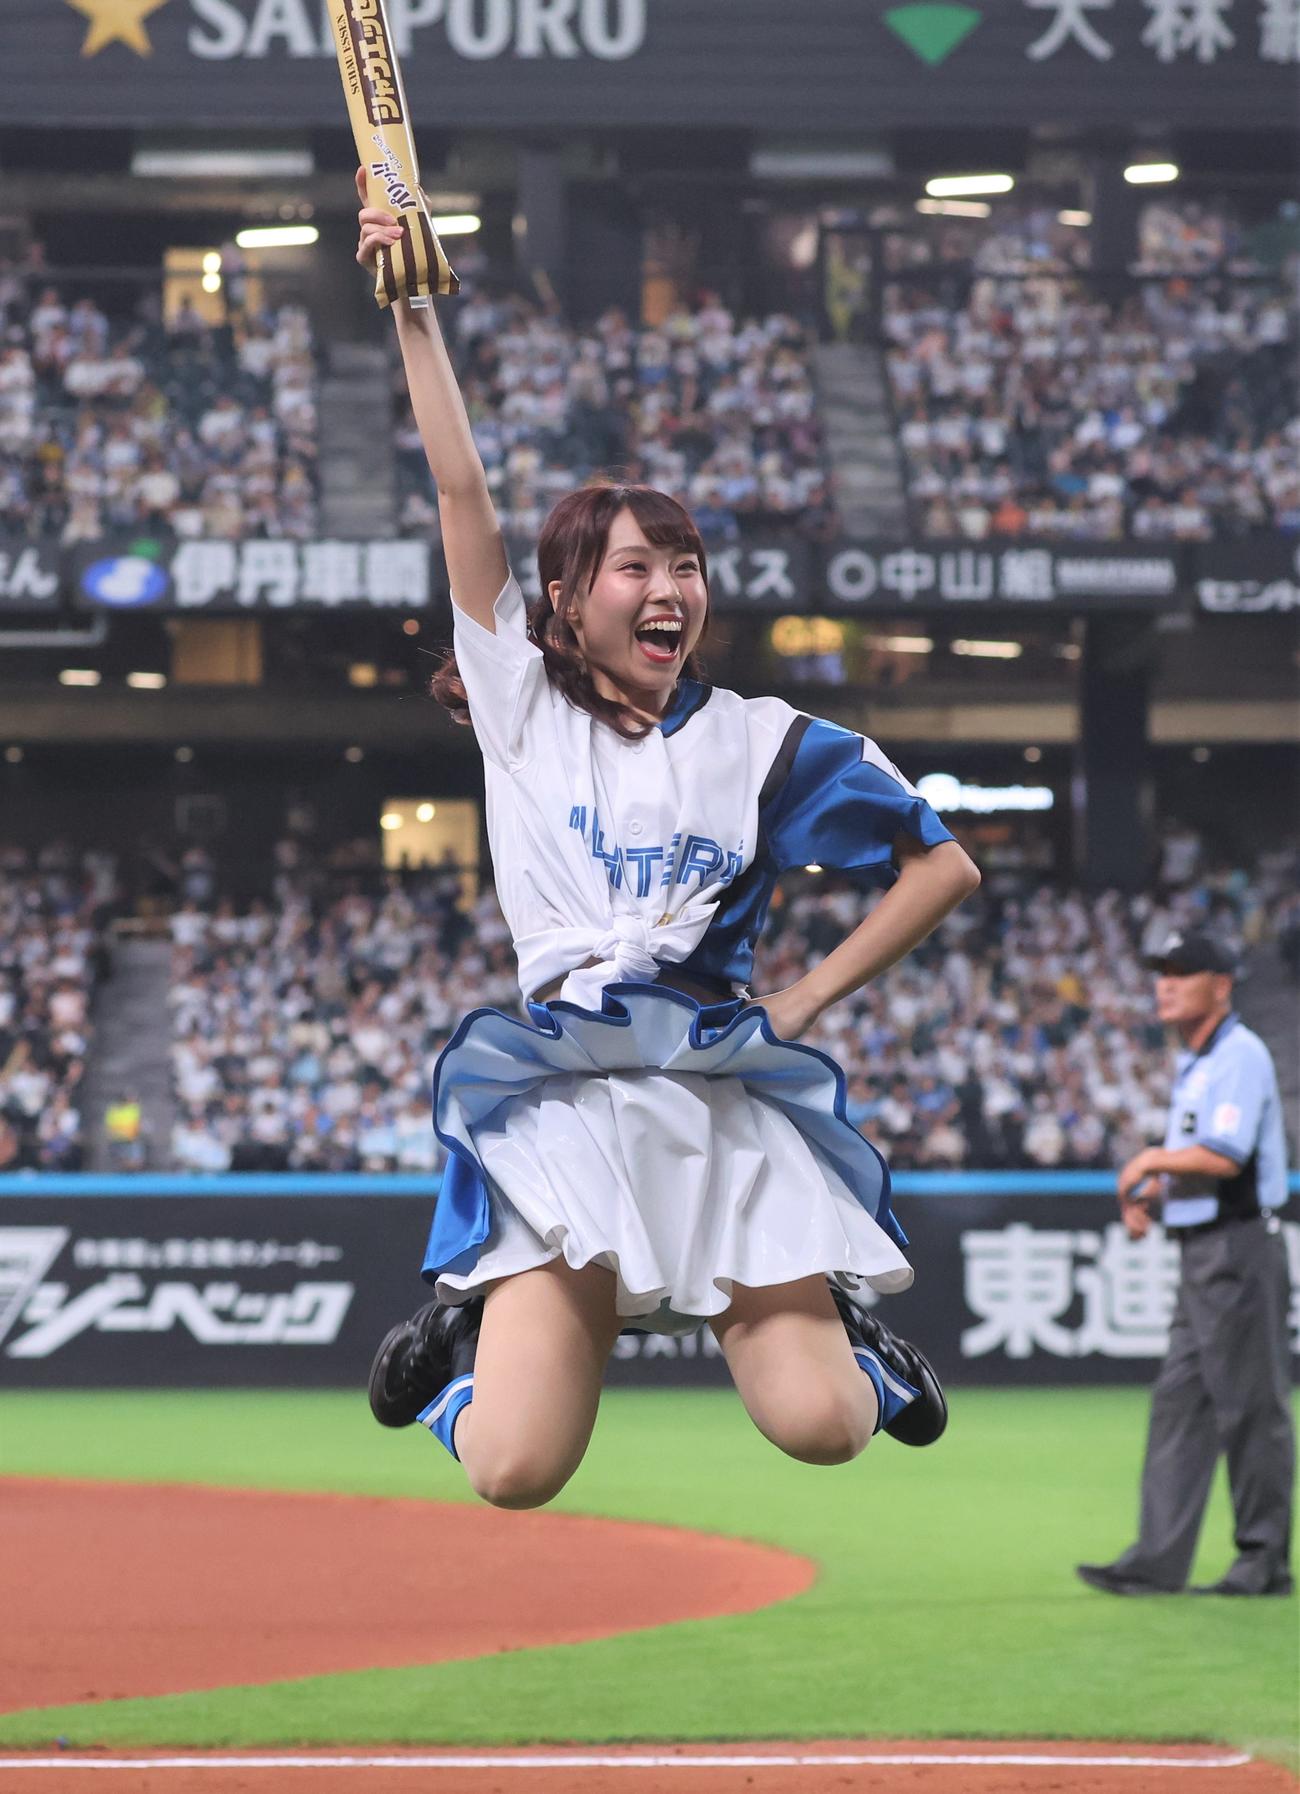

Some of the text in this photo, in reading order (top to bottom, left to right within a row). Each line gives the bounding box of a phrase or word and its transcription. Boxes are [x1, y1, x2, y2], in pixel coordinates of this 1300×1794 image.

[188, 0, 646, 60] SAPORO
[336, 14, 360, 95] SCHAU ESSEN
[1026, 0, 1300, 62] 大林
[6, 1272, 355, 1358] ジーベック
